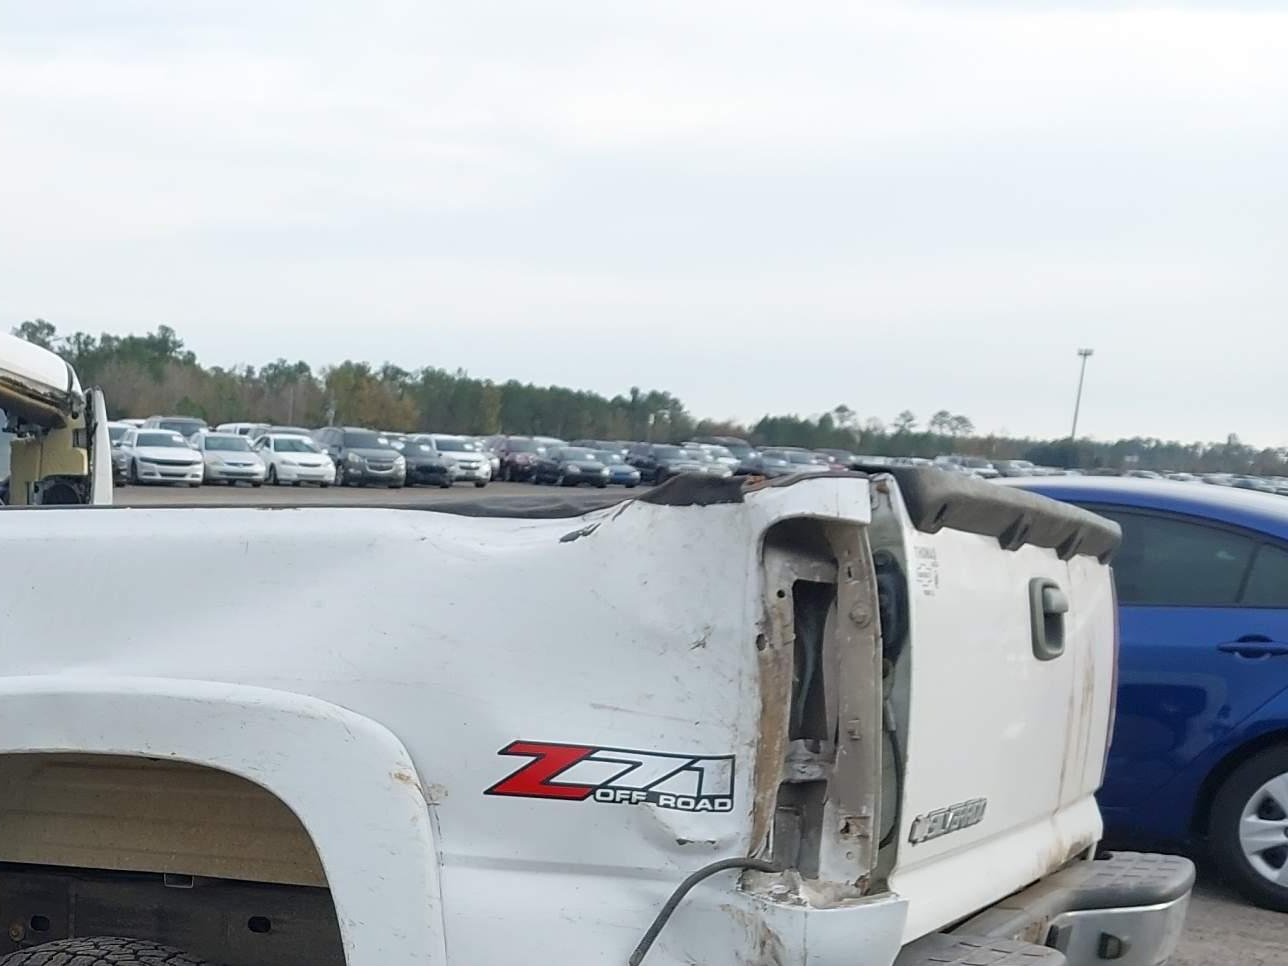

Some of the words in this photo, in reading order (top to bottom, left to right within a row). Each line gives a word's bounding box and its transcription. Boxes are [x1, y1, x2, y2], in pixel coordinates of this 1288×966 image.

[483, 739, 736, 802] Z71
[594, 787, 648, 805] OFF
[657, 796, 733, 813] ROAD
